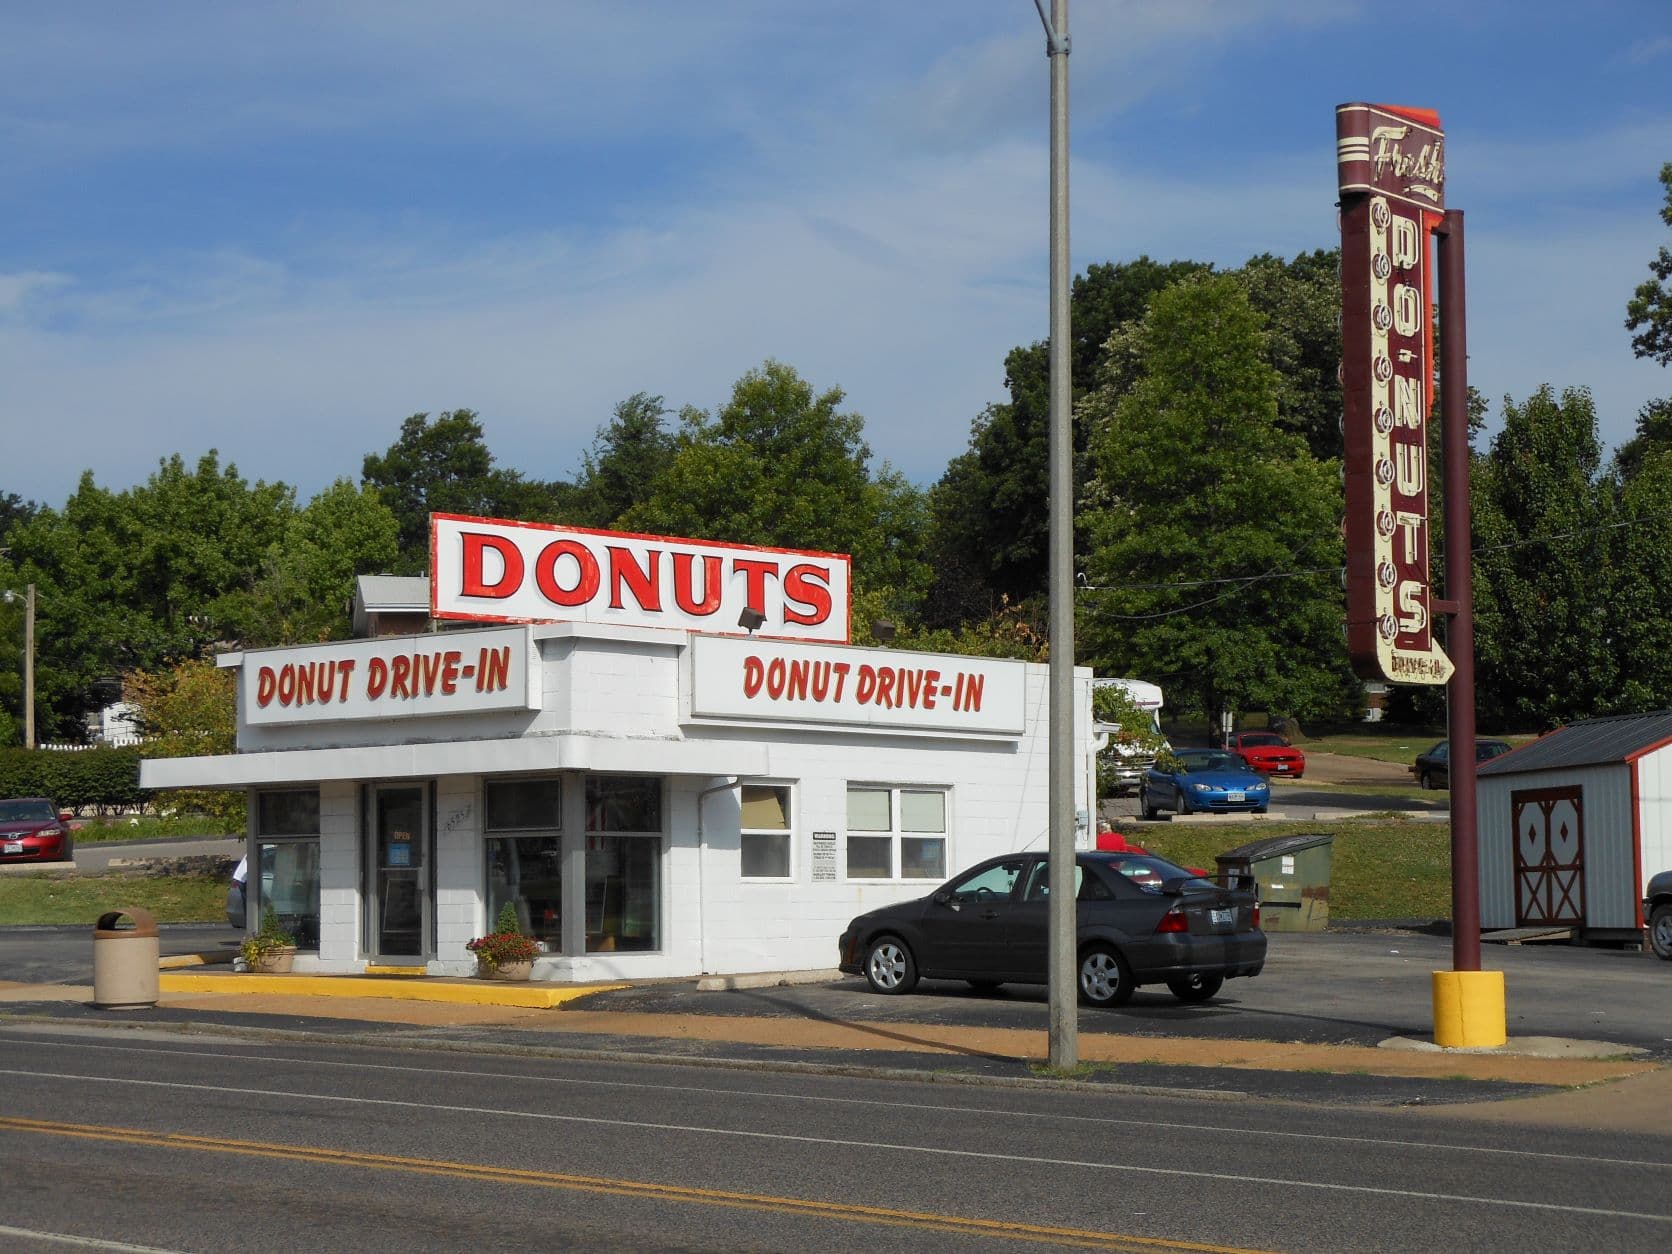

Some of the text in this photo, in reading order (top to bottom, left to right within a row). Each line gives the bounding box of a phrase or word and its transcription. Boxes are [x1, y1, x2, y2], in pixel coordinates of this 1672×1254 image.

[1371, 126, 1443, 184] Fresh
[459, 531, 832, 626] DONUTS
[257, 646, 511, 708] DONUT DRIVE-IN
[743, 655, 985, 712] DONUT DRIVE-IN
